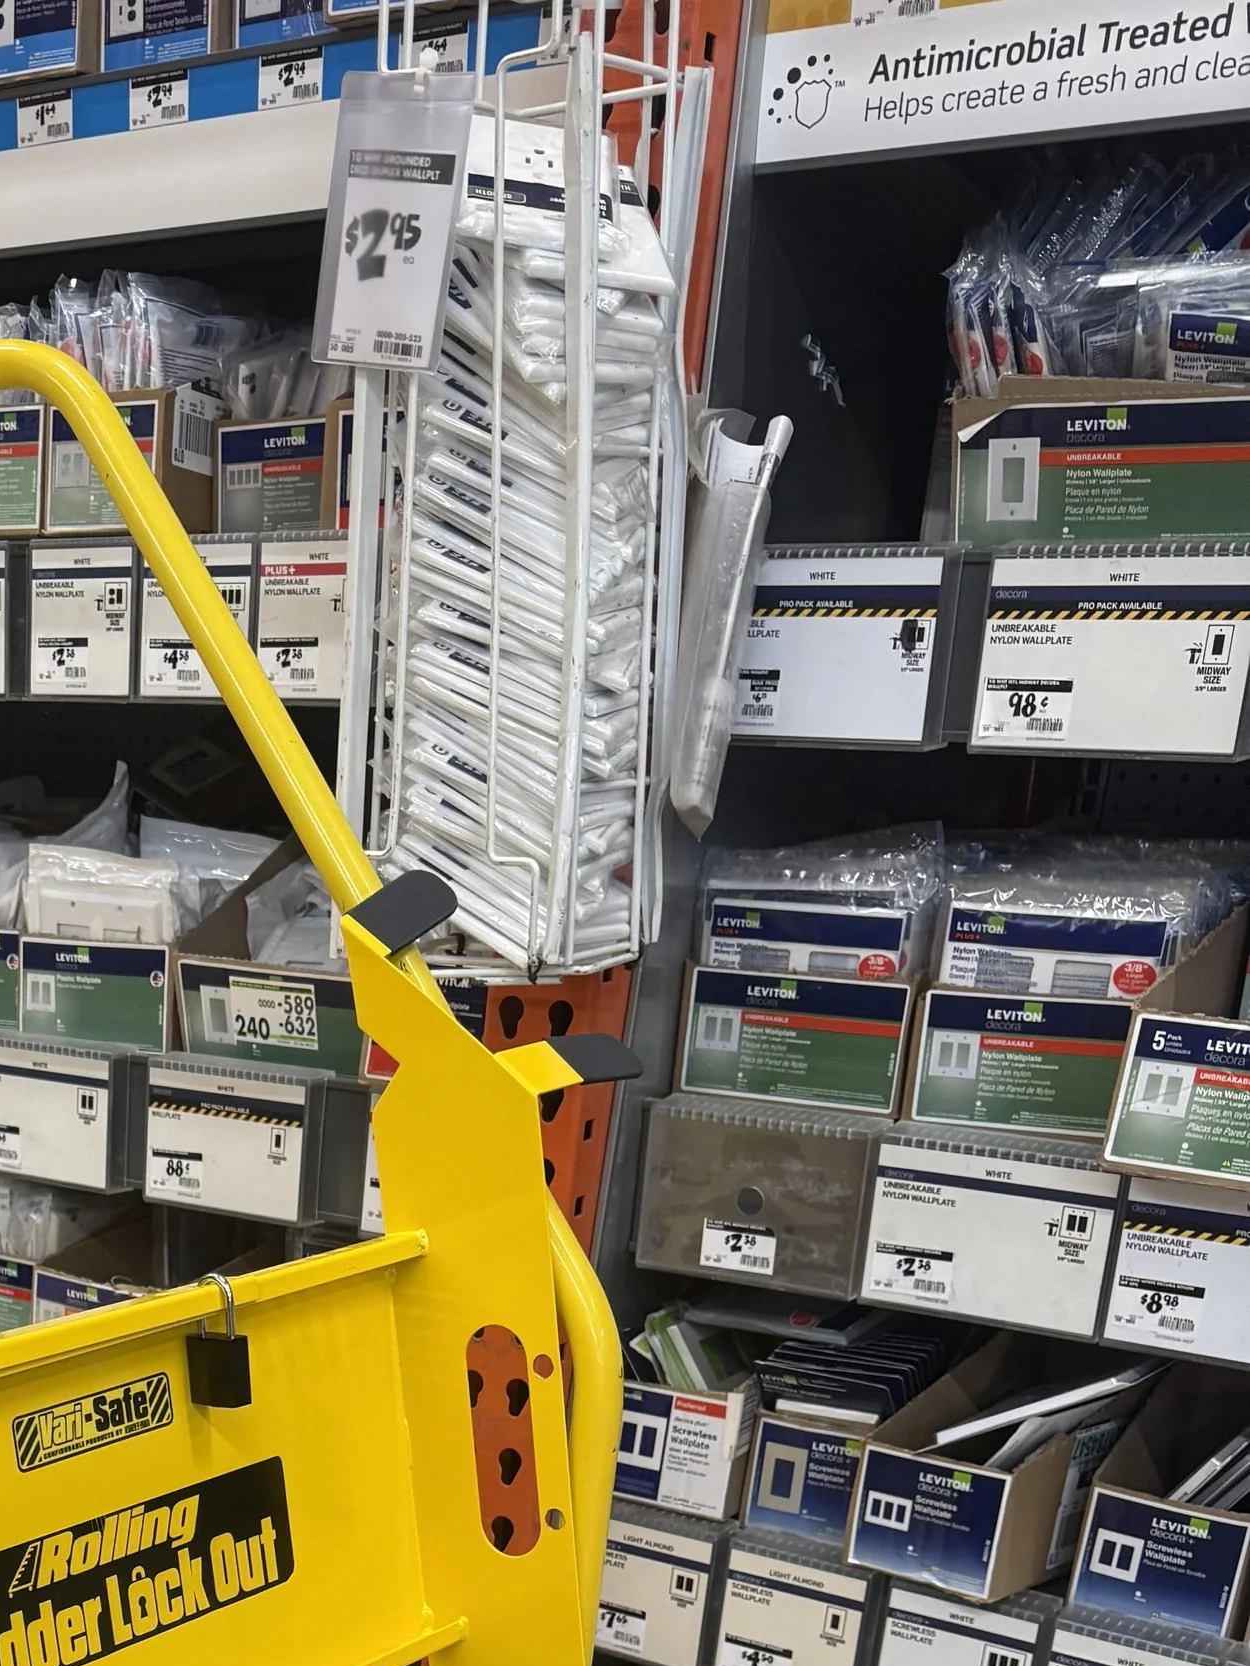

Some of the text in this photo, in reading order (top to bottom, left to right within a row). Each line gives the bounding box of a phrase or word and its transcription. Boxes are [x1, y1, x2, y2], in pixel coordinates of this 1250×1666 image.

[868, 2, 1234, 84] Antimicrobial Treated
[864, 50, 1250, 125] Helps create a fresh and clea
[403, 167, 440, 180] WALLPLT
[1178, 330, 1234, 344] LEVITON
[1067, 419, 1127, 432] LEVITON
[264, 436, 305, 448] LEVITON
[1067, 453, 1122, 461] UNBREAKABLE
[1066, 469, 1132, 478] Nylon Wallplate
[1065, 487, 1090, 496] Plaque
[265, 565, 296, 575] PLUS+
[809, 572, 836, 580] WHITE
[265, 578, 310, 586] UNBREAKABLE
[1110, 573, 1140, 582] WHITE
[996, 589, 1028, 599] decora
[816, 600, 853, 608] AVAILABLE
[1078, 602, 1163, 610] PRO PACK AVAILABLE
[991, 624, 1056, 633] UNBREAKABLE
[990, 636, 1072, 645] NYLON WALLPLATE
[1197, 667, 1231, 676] MIDWAY
[1203, 675, 1221, 684] SIZE
[717, 918, 760, 928] LEVITON
[957, 921, 1004, 934] LEVITON
[56, 953, 90, 964] LEVITON
[747, 986, 797, 999] LEVITON
[987, 1008, 1043, 1022] LEVITON
[235, 1014, 270, 1040] 240
[984, 1038, 1034, 1048] UNBREAKABLE
[1152, 1030, 1167, 1051] 5
[1206, 1039, 1250, 1056] LEVIT
[982, 1051, 1042, 1063] Nylon Wallplate
[1204, 1053, 1246, 1066] decora
[1187, 1122, 1246, 1139] Placas de Pared
[985, 1169, 1012, 1180] WHITE
[884, 1181, 942, 1195] UNBREAKABLE
[882, 1191, 956, 1208] NYLON WALLPLATE
[1127, 1232, 1192, 1249] UNBREAKABLE
[1126, 1242, 1208, 1261] NYLON WALLPLATE
[38, 1387, 149, 1450] Vari-Safe
[86, 1432, 114, 1447] PRODUCTS
[672, 1425, 717, 1442] Screwless
[671, 1436, 710, 1450] Wallplate
[919, 1472, 971, 1492] LEVITON
[915, 1495, 958, 1512] Screwless
[914, 1503, 952, 1520] Wallplate
[1152, 1517, 1209, 1539] LEVITON
[37, 1494, 200, 1589] Rolling
[1147, 1540, 1193, 1558] Screwless
[1145, 1549, 1187, 1566] Wallplate
[106, 1555, 210, 1646] Lock
[212, 1517, 279, 1602] Out
[731, 1582, 774, 1598] SCREWLESS
[730, 1590, 771, 1606] WALLPLATE
[950, 1612, 975, 1624] WHITE
[891, 1621, 936, 1637] SCREWLESS
[890, 1629, 933, 1646] WALLPLATE
